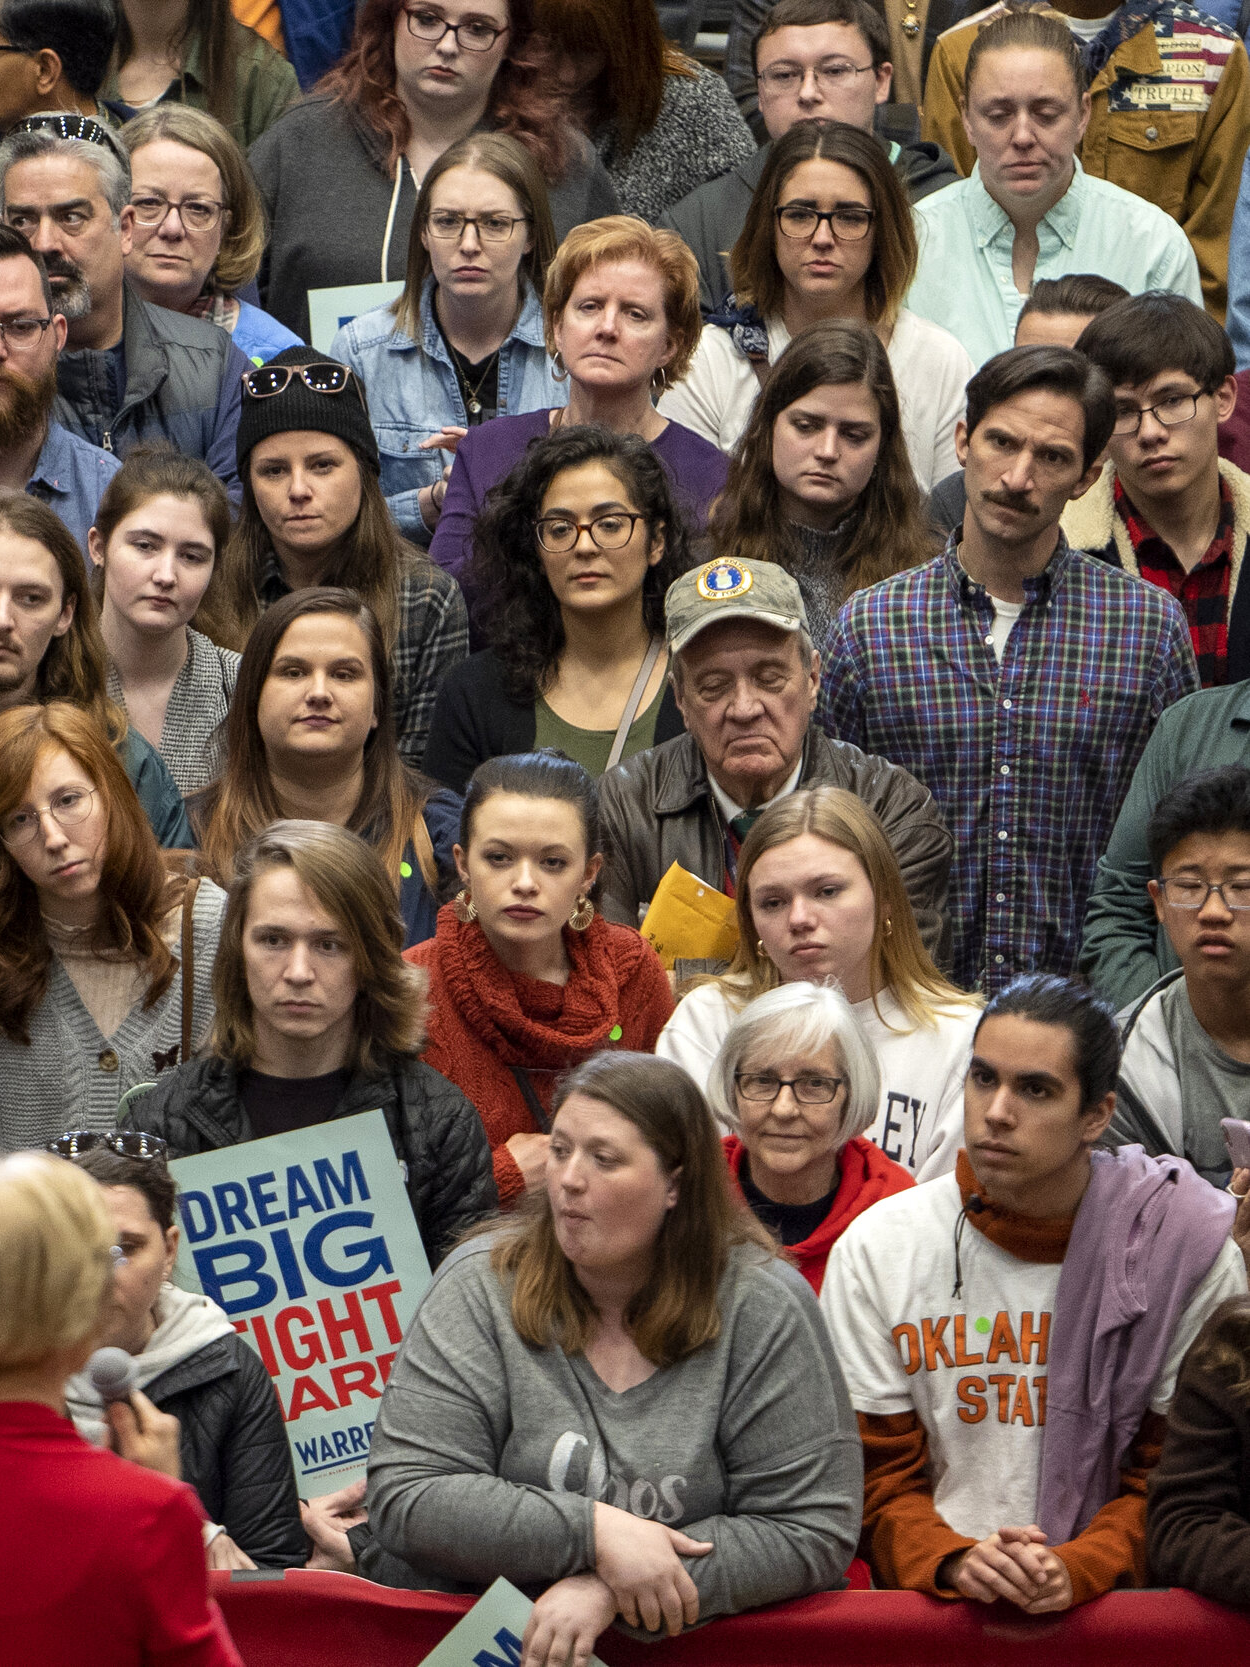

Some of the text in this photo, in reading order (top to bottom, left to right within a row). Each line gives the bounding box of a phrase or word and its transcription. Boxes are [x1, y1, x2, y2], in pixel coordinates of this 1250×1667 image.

[1134, 86, 1194, 100] TRUTH
[1161, 64, 1201, 73] PION
[872, 1091, 927, 1168] EY
[177, 1150, 372, 1244] DREAM
[192, 1211, 395, 1315] BIG
[891, 1310, 1052, 1376] OKLAH
[274, 1351, 397, 1423] AR
